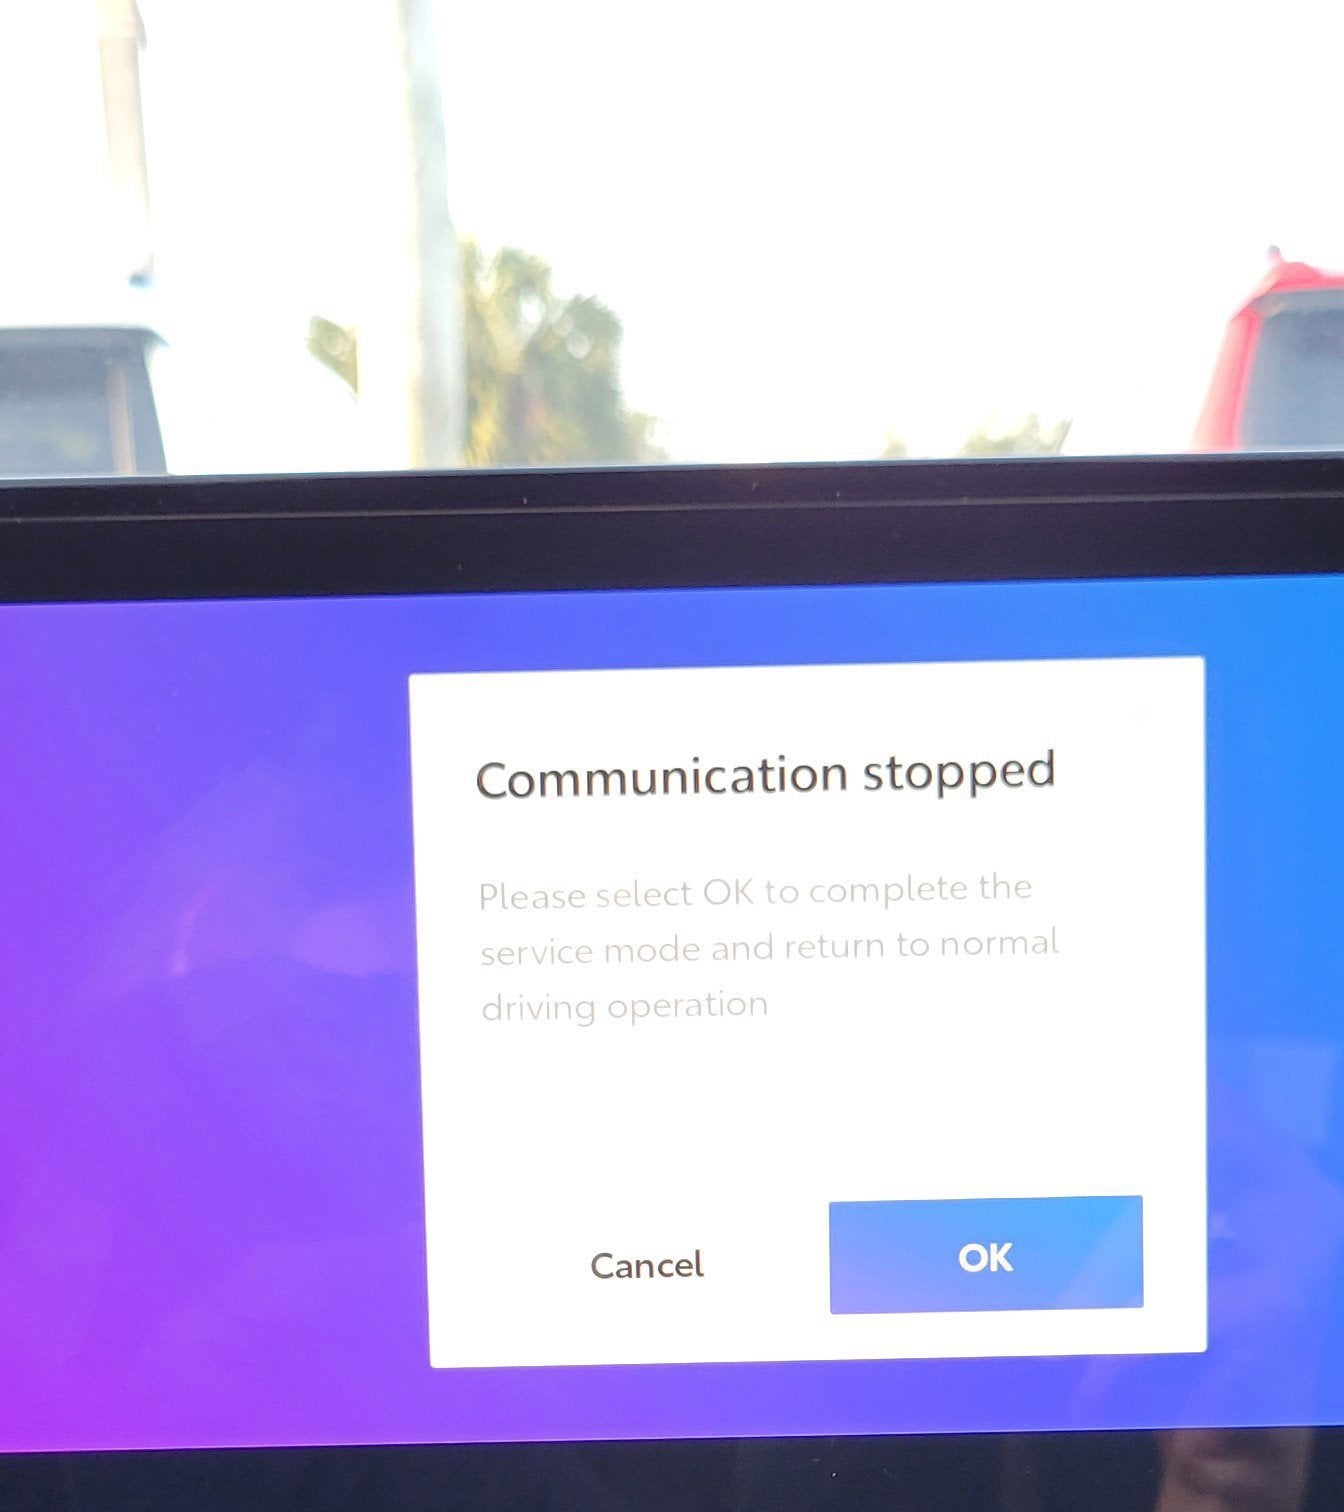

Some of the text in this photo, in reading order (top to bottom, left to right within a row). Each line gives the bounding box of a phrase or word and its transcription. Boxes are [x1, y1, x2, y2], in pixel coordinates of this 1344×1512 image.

[476, 749, 1056, 799] Communication stopped
[479, 872, 1033, 911] Please select OK to complete the
[481, 926, 1060, 967] service mode and return to normal
[481, 989, 768, 1029] driving operation
[590, 1250, 705, 1280] Cancel
[958, 1241, 1014, 1274] OK
